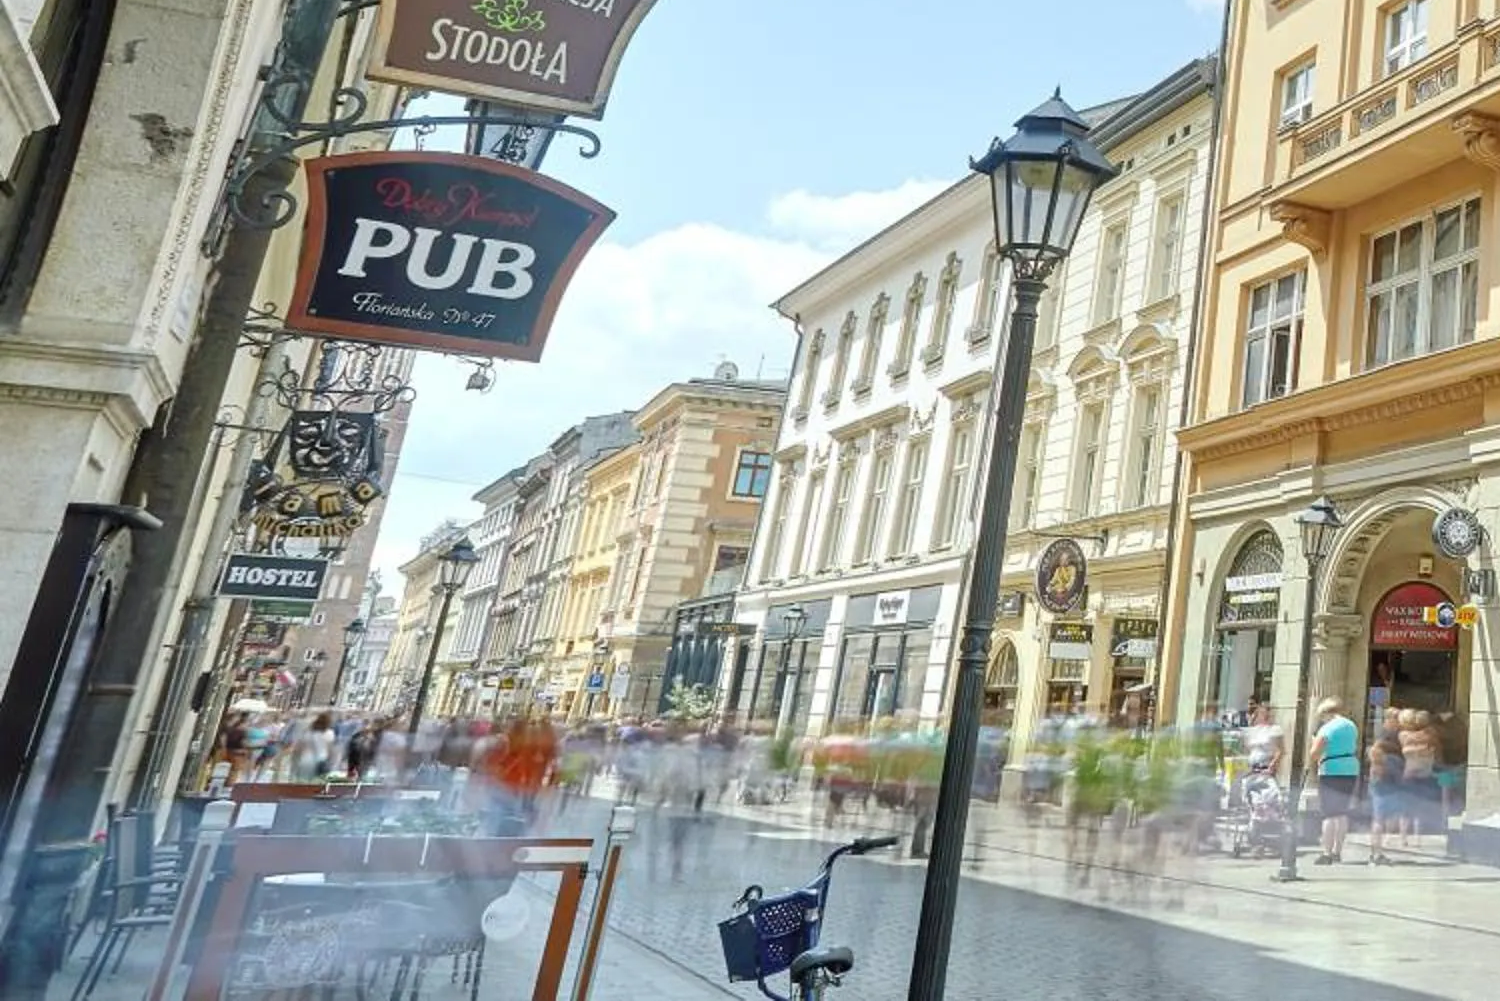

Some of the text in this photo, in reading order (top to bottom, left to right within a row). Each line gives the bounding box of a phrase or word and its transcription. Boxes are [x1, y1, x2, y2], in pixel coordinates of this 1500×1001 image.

[425, 18, 568, 85] STODOŁA
[336, 217, 537, 300] PUB
[471, 312, 497, 328] 47
[227, 566, 319, 588] HOSTEL
